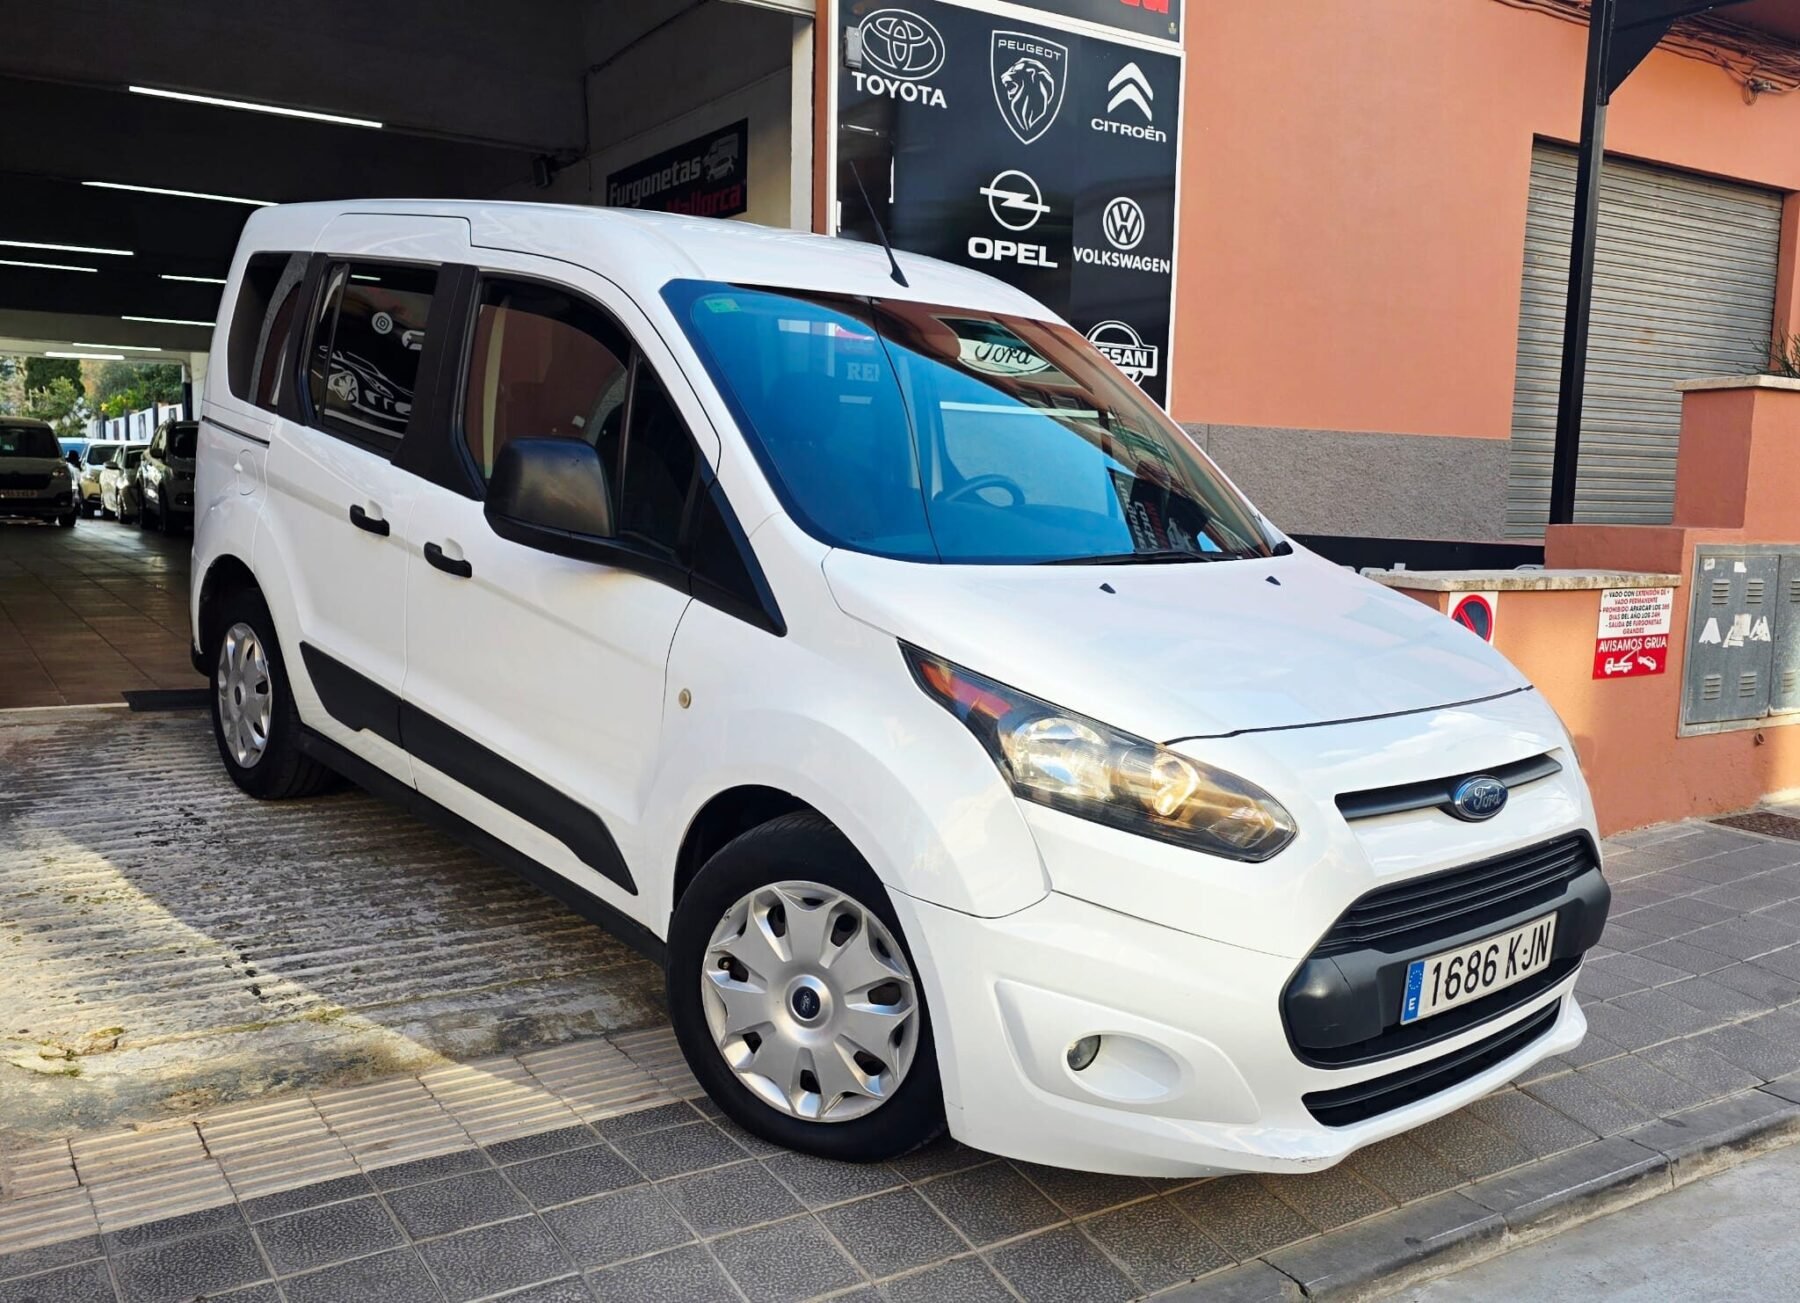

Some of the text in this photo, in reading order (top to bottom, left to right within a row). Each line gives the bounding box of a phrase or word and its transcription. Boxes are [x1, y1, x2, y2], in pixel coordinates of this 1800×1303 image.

[998, 38, 1061, 61] PEUGEOT
[852, 71, 948, 109] TOYOTA
[609, 156, 701, 207] Furgonetas
[967, 236, 1058, 269] OPEL
[1073, 246, 1171, 274] VOLKSWAGEN
[1598, 638, 1642, 653] AVISAMOS
[1473, 785, 1500, 810] Ford
[1432, 944, 1499, 1006] 1686
[1408, 997, 1416, 1011] E
